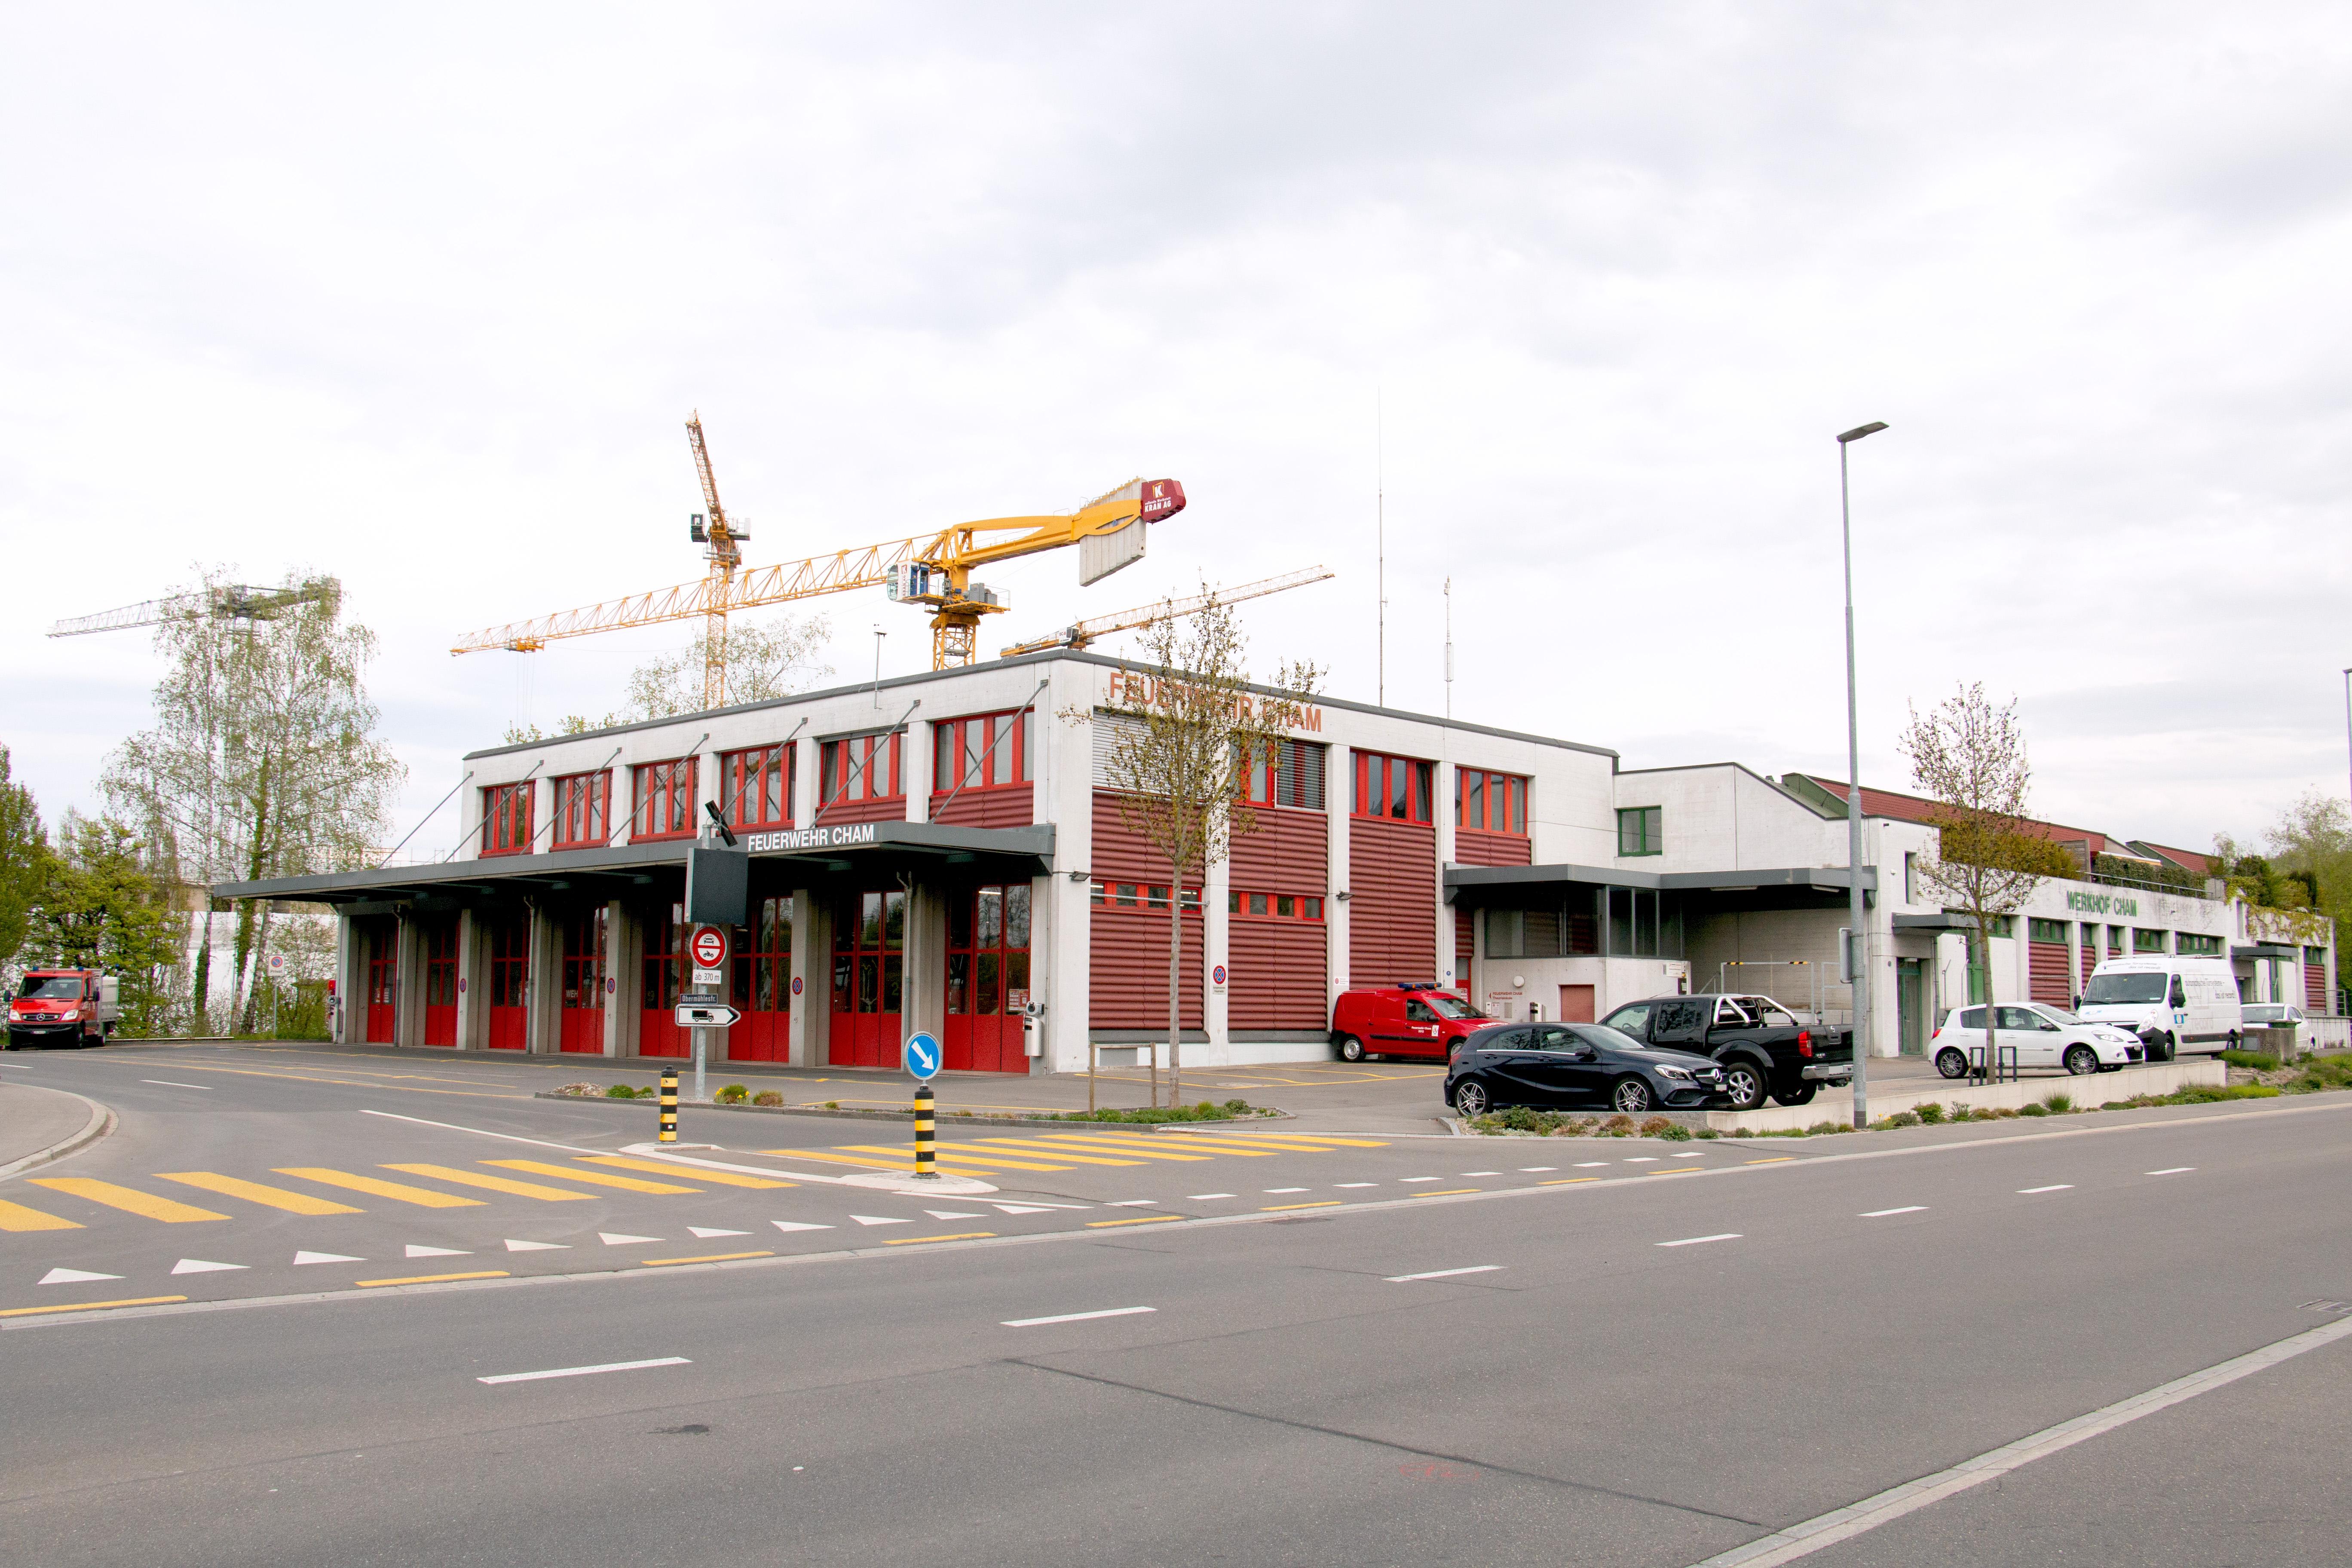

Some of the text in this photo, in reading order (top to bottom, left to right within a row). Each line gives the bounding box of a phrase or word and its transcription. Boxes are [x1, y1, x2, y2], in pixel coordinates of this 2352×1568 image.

[1155, 484, 1163, 498] K
[1145, 500, 1171, 512] KRAN AG
[1263, 700, 1321, 732] CHAM
[748, 824, 874, 851] FEUERWEHR CHAM
[2067, 891, 2137, 917] WERKHOF CHAM
[695, 972, 701, 980] ab
[891, 982, 899, 996] 2
